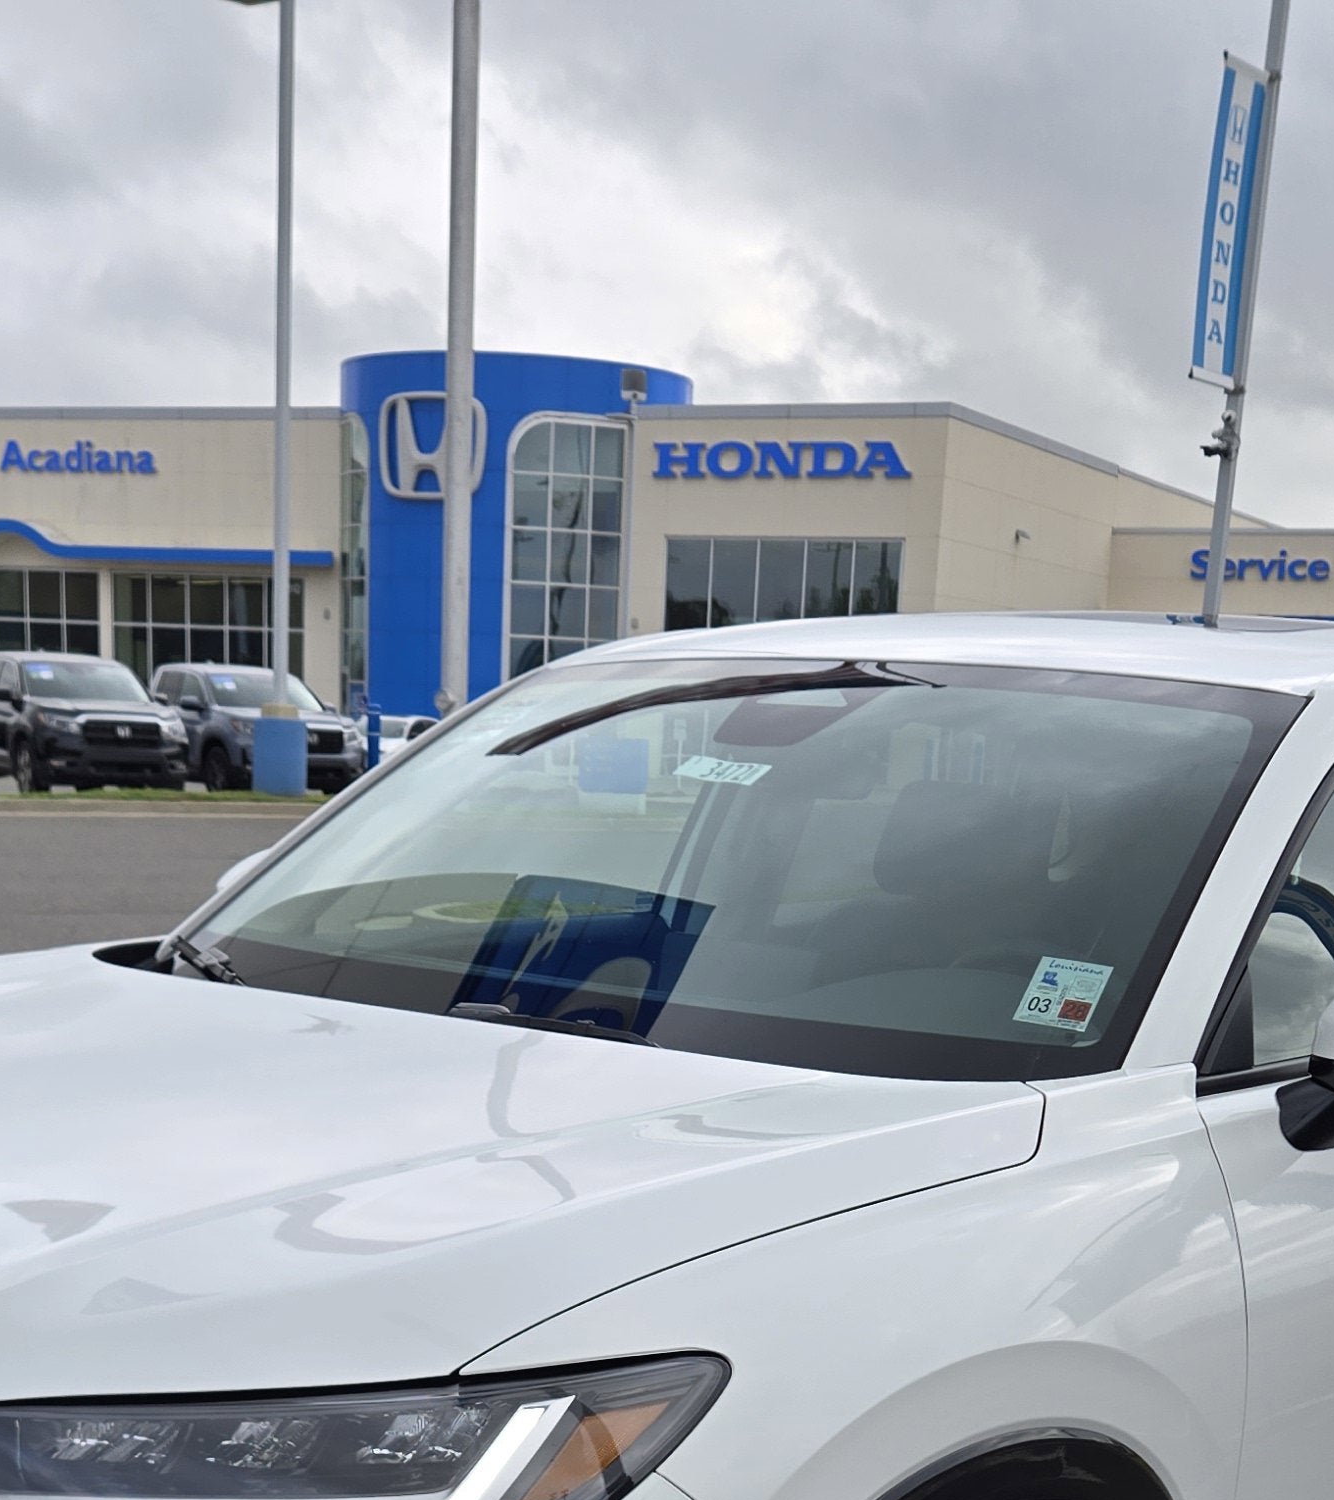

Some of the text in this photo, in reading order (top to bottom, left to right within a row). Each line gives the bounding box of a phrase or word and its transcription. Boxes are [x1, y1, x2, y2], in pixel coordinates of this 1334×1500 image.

[1206, 157, 1243, 346] HONDA
[0, 438, 157, 475] Acadiana
[652, 440, 913, 480] HONDA
[1190, 548, 1330, 583] Service
[1049, 959, 1104, 975] Louisiana
[1027, 996, 1052, 1013] 03
